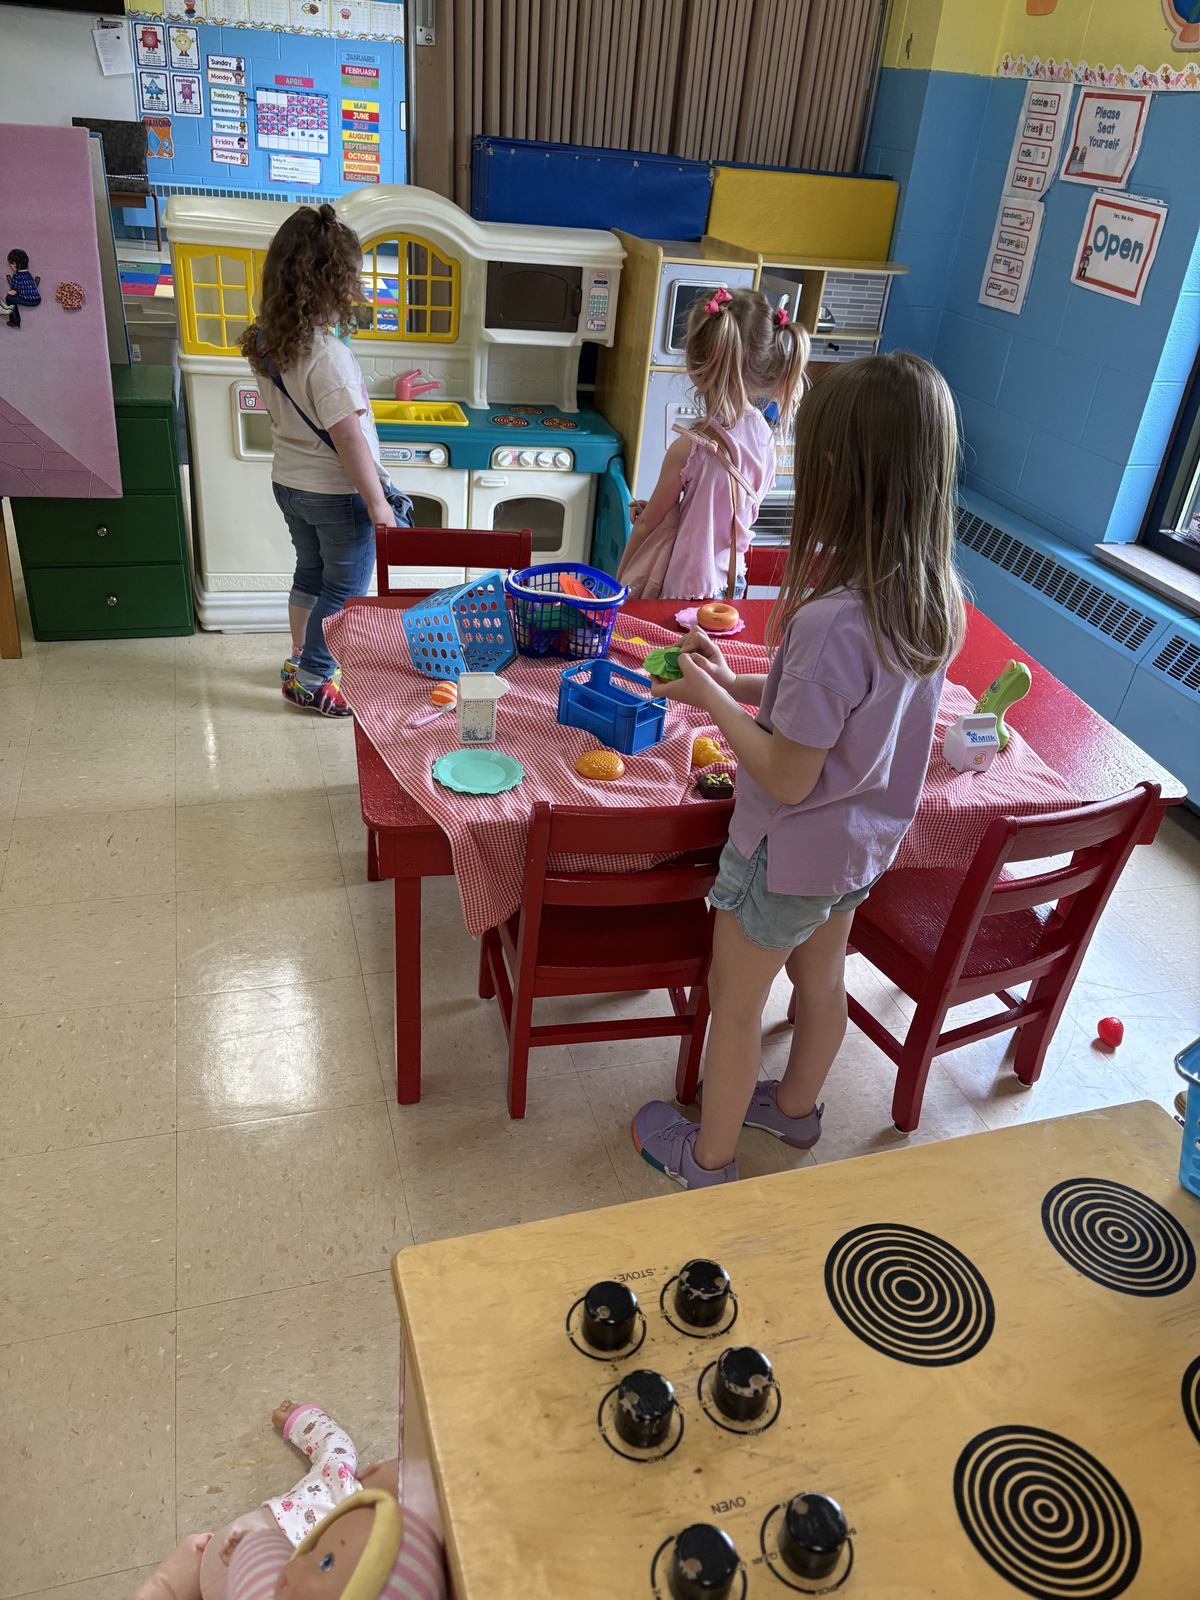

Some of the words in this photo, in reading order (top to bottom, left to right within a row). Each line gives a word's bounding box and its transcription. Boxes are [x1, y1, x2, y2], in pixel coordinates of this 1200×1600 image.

[210, 58, 232, 68] Sunday
[346, 54, 375, 63] JANUARY
[345, 67, 376, 76] FEBRUARY
[210, 72, 232, 82] Monday
[285, 78, 304, 86] APRIL
[213, 91, 235, 101] Tuesday
[213, 107, 239, 116] Wednesday
[353, 112, 370, 120] JUNE
[1095, 106, 1120, 120] Please
[215, 122, 238, 131] Thursday
[1027, 123, 1039, 132] fries
[1098, 122, 1115, 134] Seat
[348, 132, 374, 141] AUGUST
[214, 138, 234, 147] Friday
[344, 142, 379, 151] SEPTEMBER
[1089, 136, 1120, 150] Yourself
[215, 152, 238, 162] Saturday
[348, 152, 376, 161] OCTOBER
[1021, 149, 1032, 157] milk
[345, 163, 378, 172] NOVEMBER
[346, 173, 377, 182] DECEMBER
[1015, 173, 1027, 183] juice
[1093, 225, 1143, 264] Open
[710, 1496, 746, 1514] OVEN
